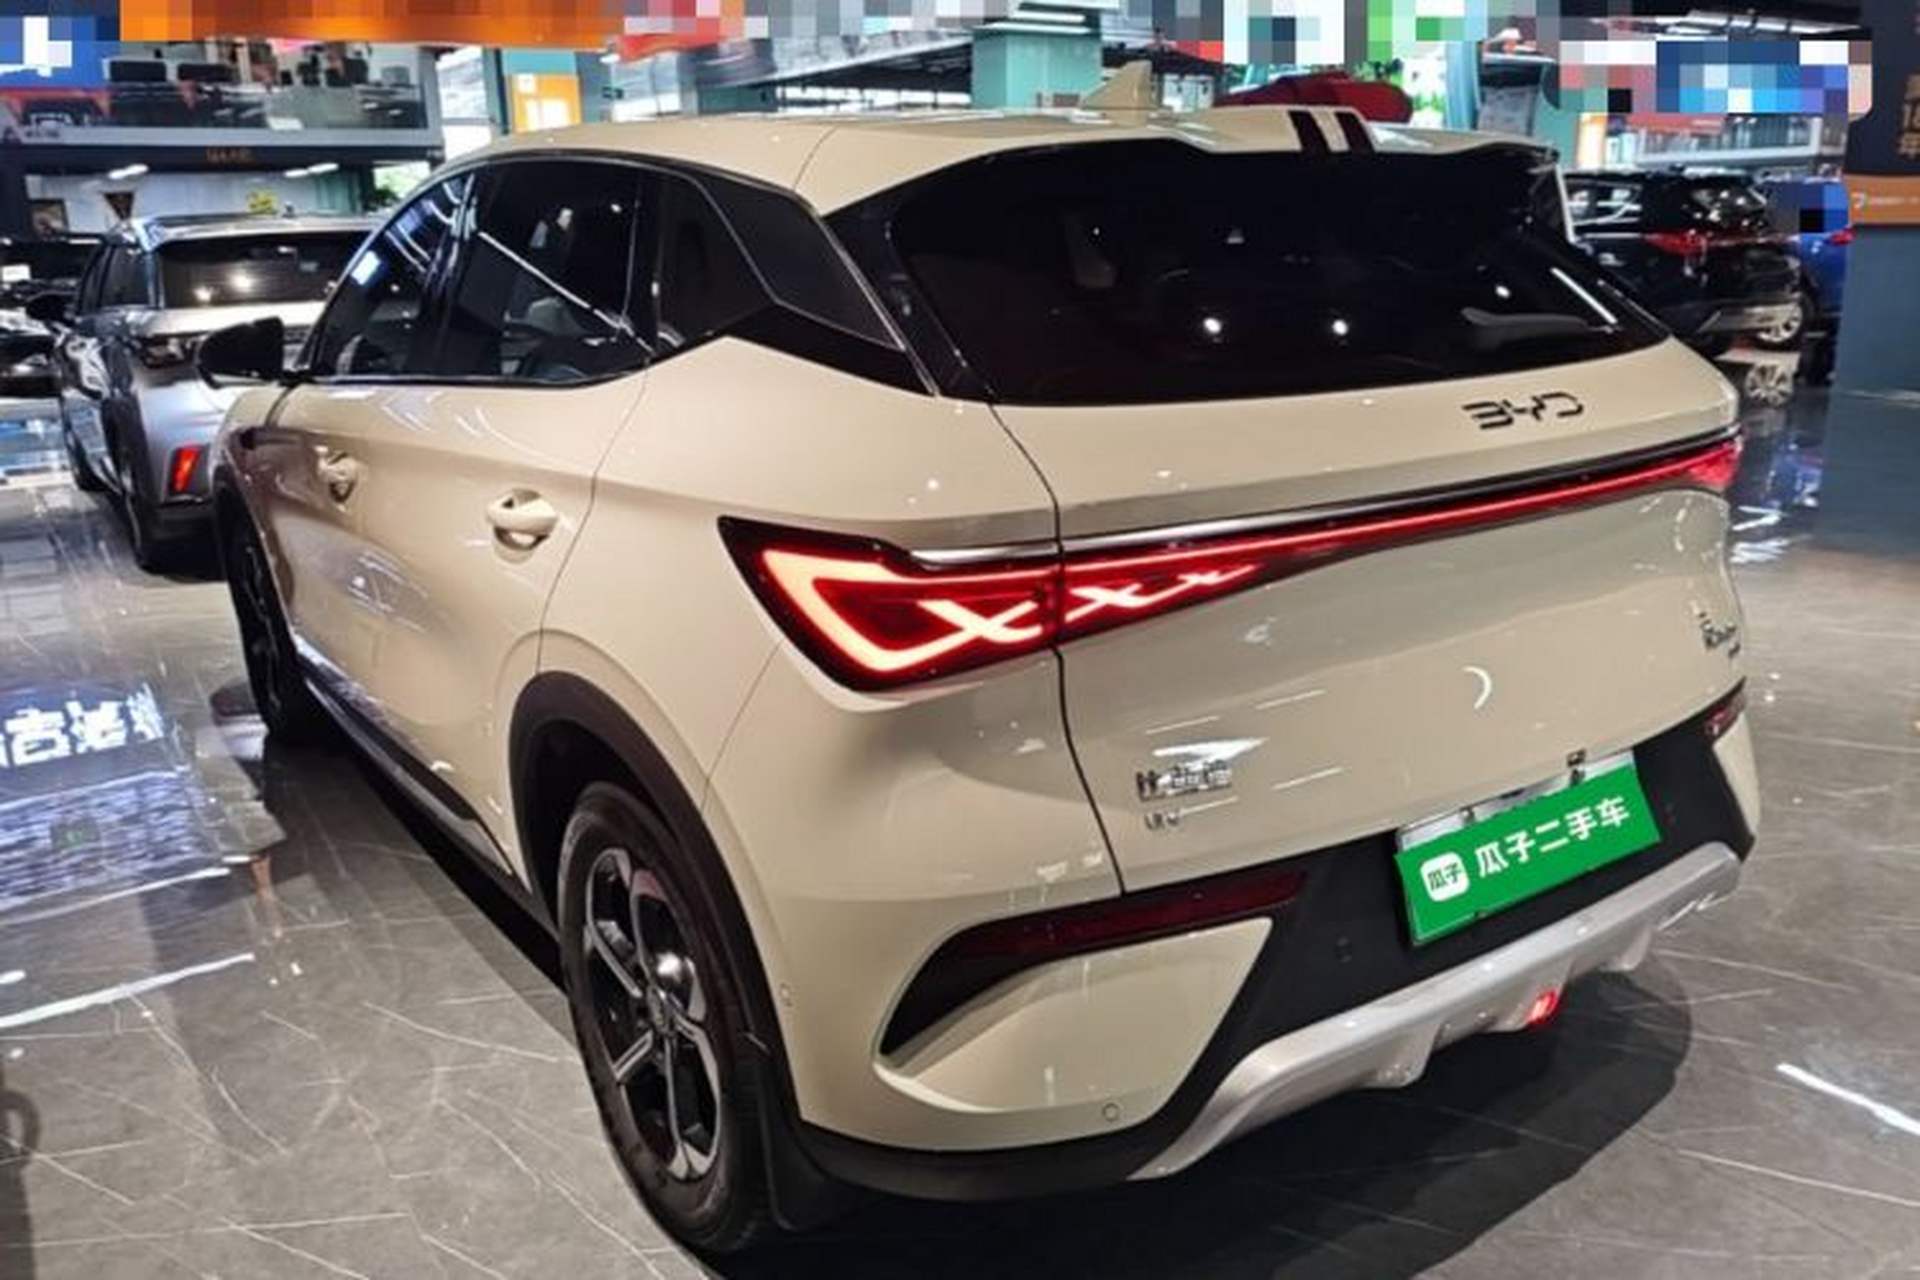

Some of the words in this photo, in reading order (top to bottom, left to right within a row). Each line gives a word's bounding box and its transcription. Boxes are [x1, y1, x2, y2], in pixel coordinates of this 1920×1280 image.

[1461, 391, 1584, 430] BYD
[1475, 797, 1631, 878] 瓜子二手车
[1427, 861, 1463, 892] 瓜子
